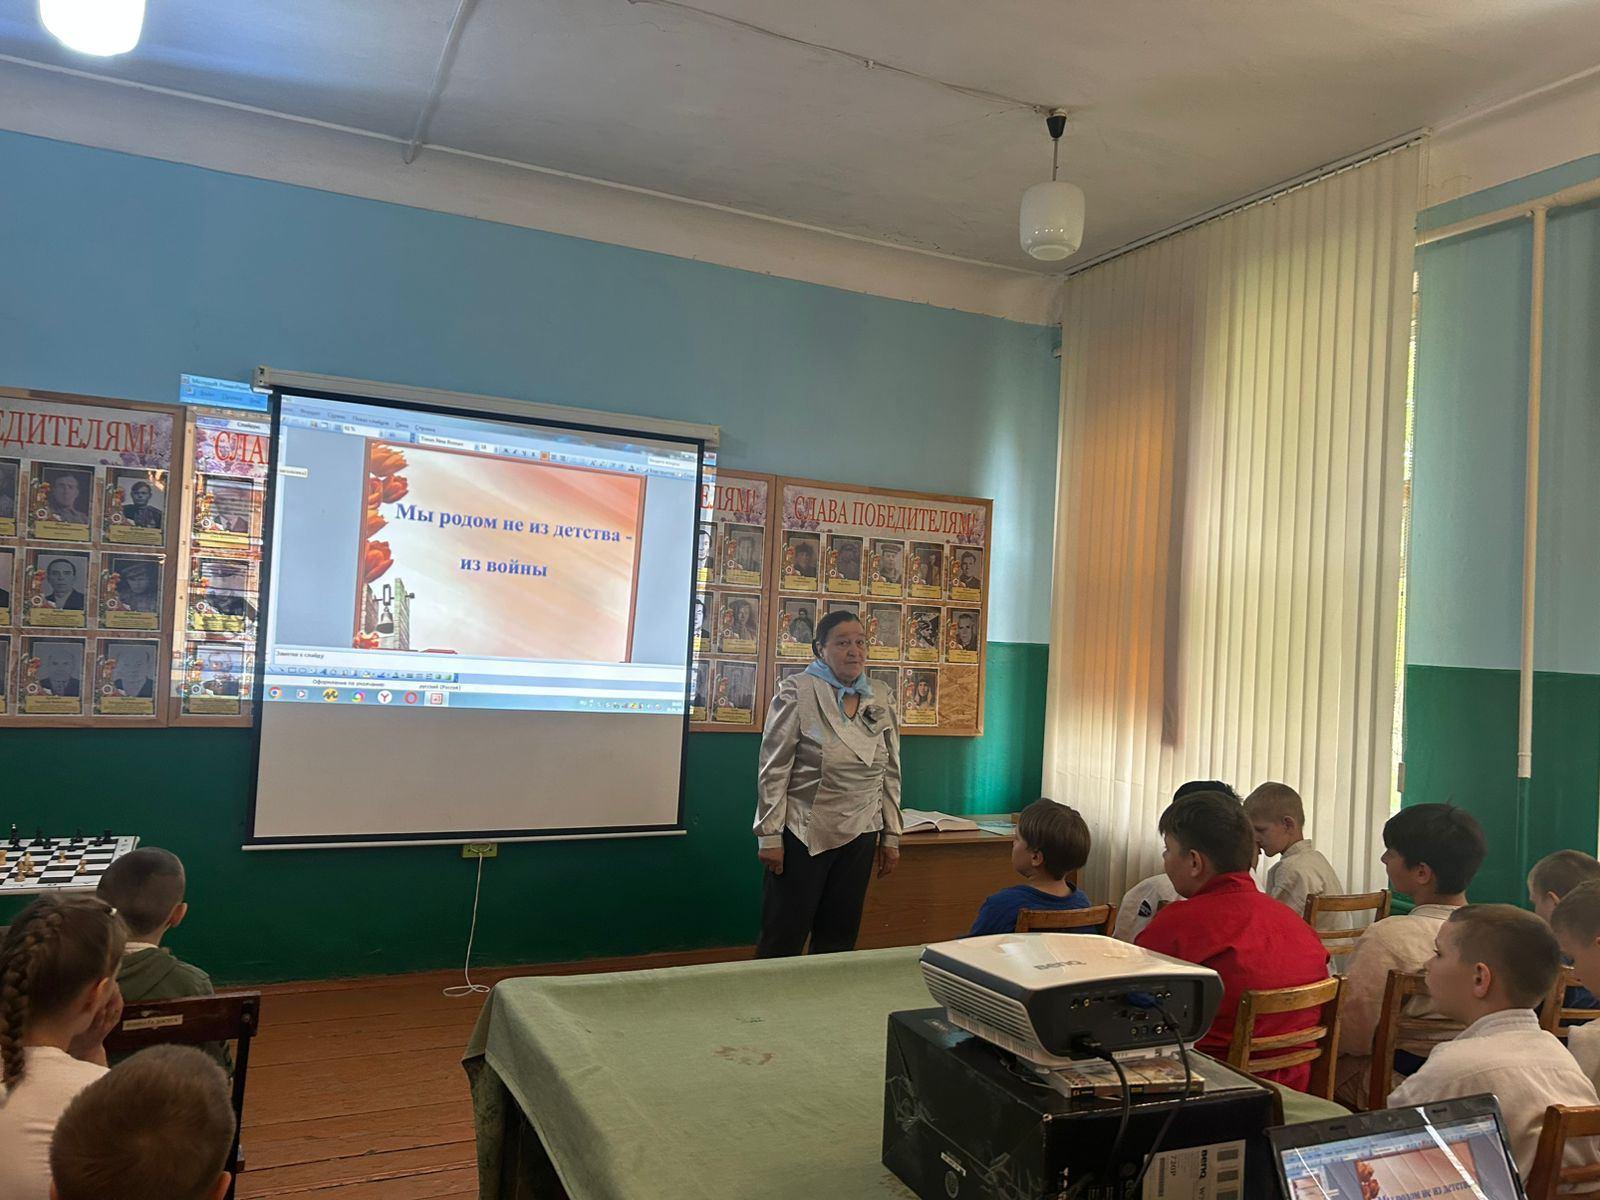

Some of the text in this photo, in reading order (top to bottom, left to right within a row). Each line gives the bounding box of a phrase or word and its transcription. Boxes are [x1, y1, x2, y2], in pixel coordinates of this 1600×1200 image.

[0, 409, 155, 455] ДИТЕЛЯМ!
[214, 431, 271, 465] СЛА
[395, 502, 433, 523] Мы
[439, 511, 498, 530] родом
[502, 519, 525, 532] не
[529, 523, 549, 535] из
[553, 524, 621, 542] детства
[795, 495, 977, 535] СЛАВА ПОБЕДИТЕЛЯМ!
[460, 557, 548, 577] из войны
[1033, 960, 1087, 970] BenQ
